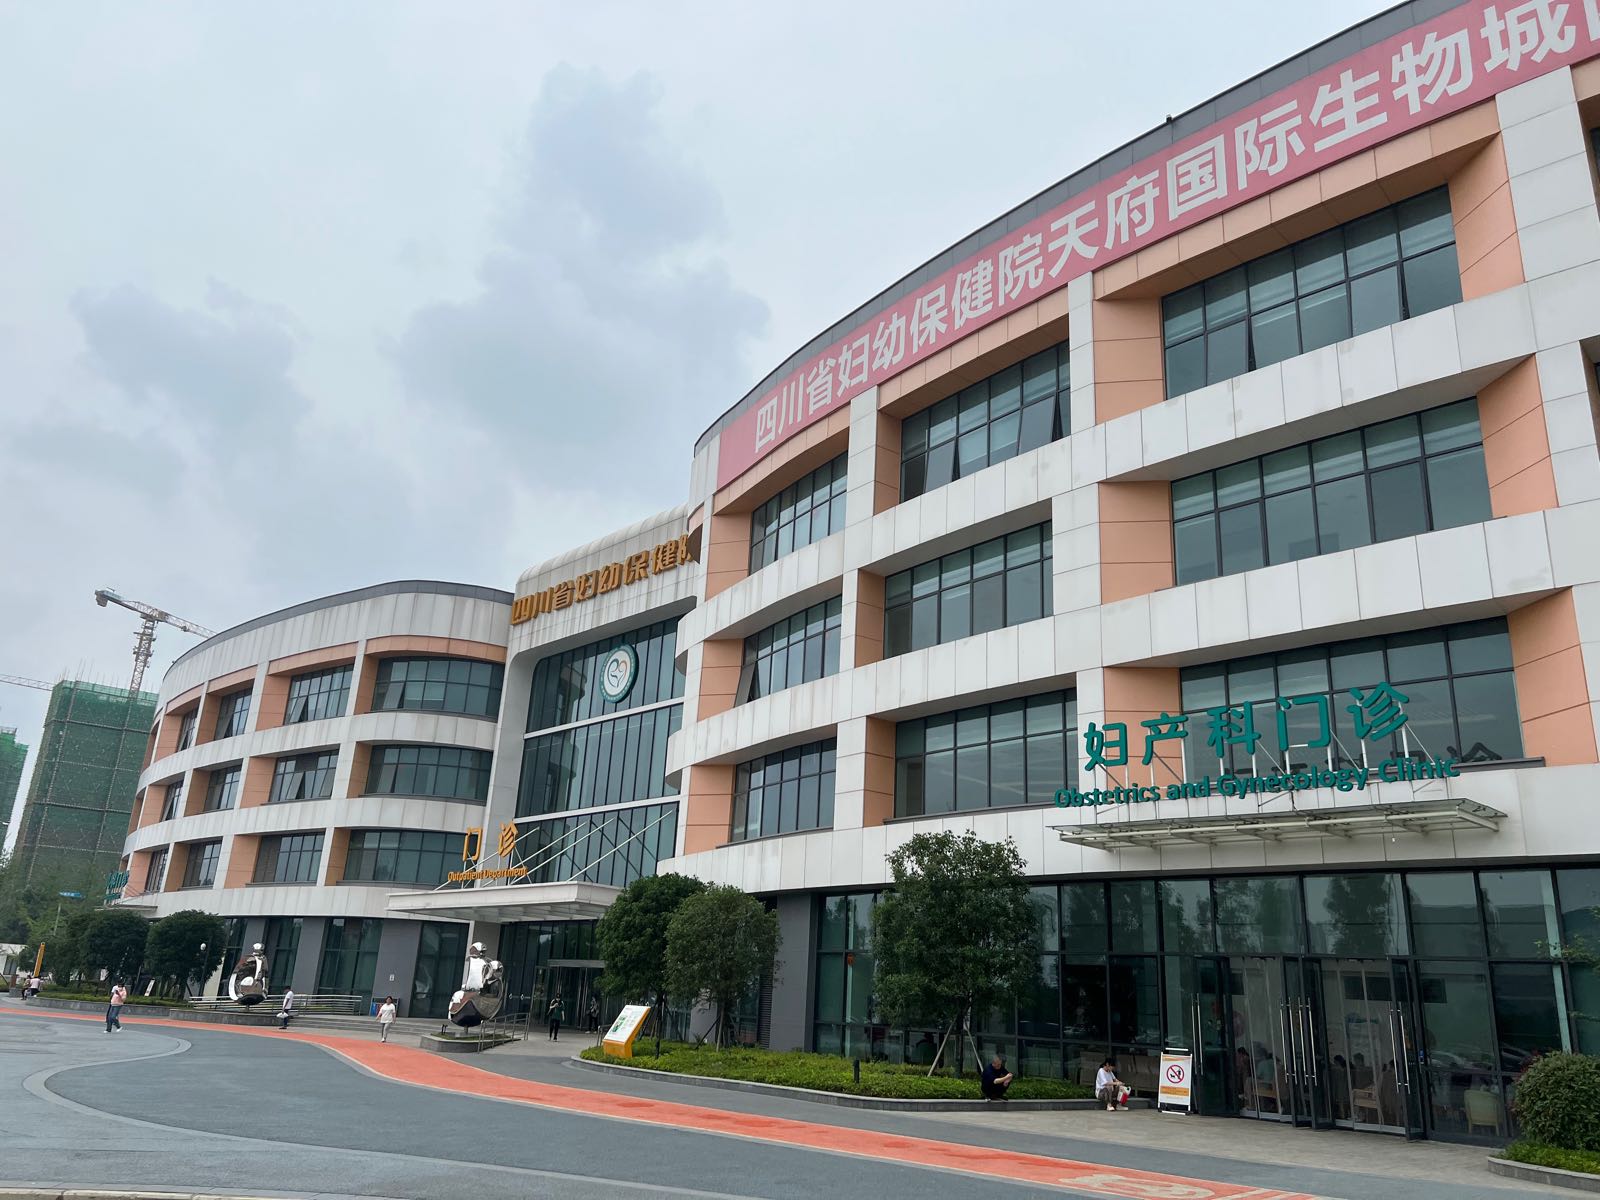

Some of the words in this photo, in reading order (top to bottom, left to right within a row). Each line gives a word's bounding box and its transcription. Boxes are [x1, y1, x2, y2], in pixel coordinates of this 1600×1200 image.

[755, 0, 1600, 453] 四川省妇幼保健院天府国际生物城
[1083, 681, 1410, 772] 妇产科门诊
[1054, 782, 1161, 808] Obstetrics
[1166, 775, 1210, 801] and
[1217, 765, 1369, 800] Gynecology
[1379, 756, 1461, 783] Clinic
[462, 821, 519, 862] 门诊
[448, 870, 484, 882] Outpatient
[484, 866, 528, 880] Department
